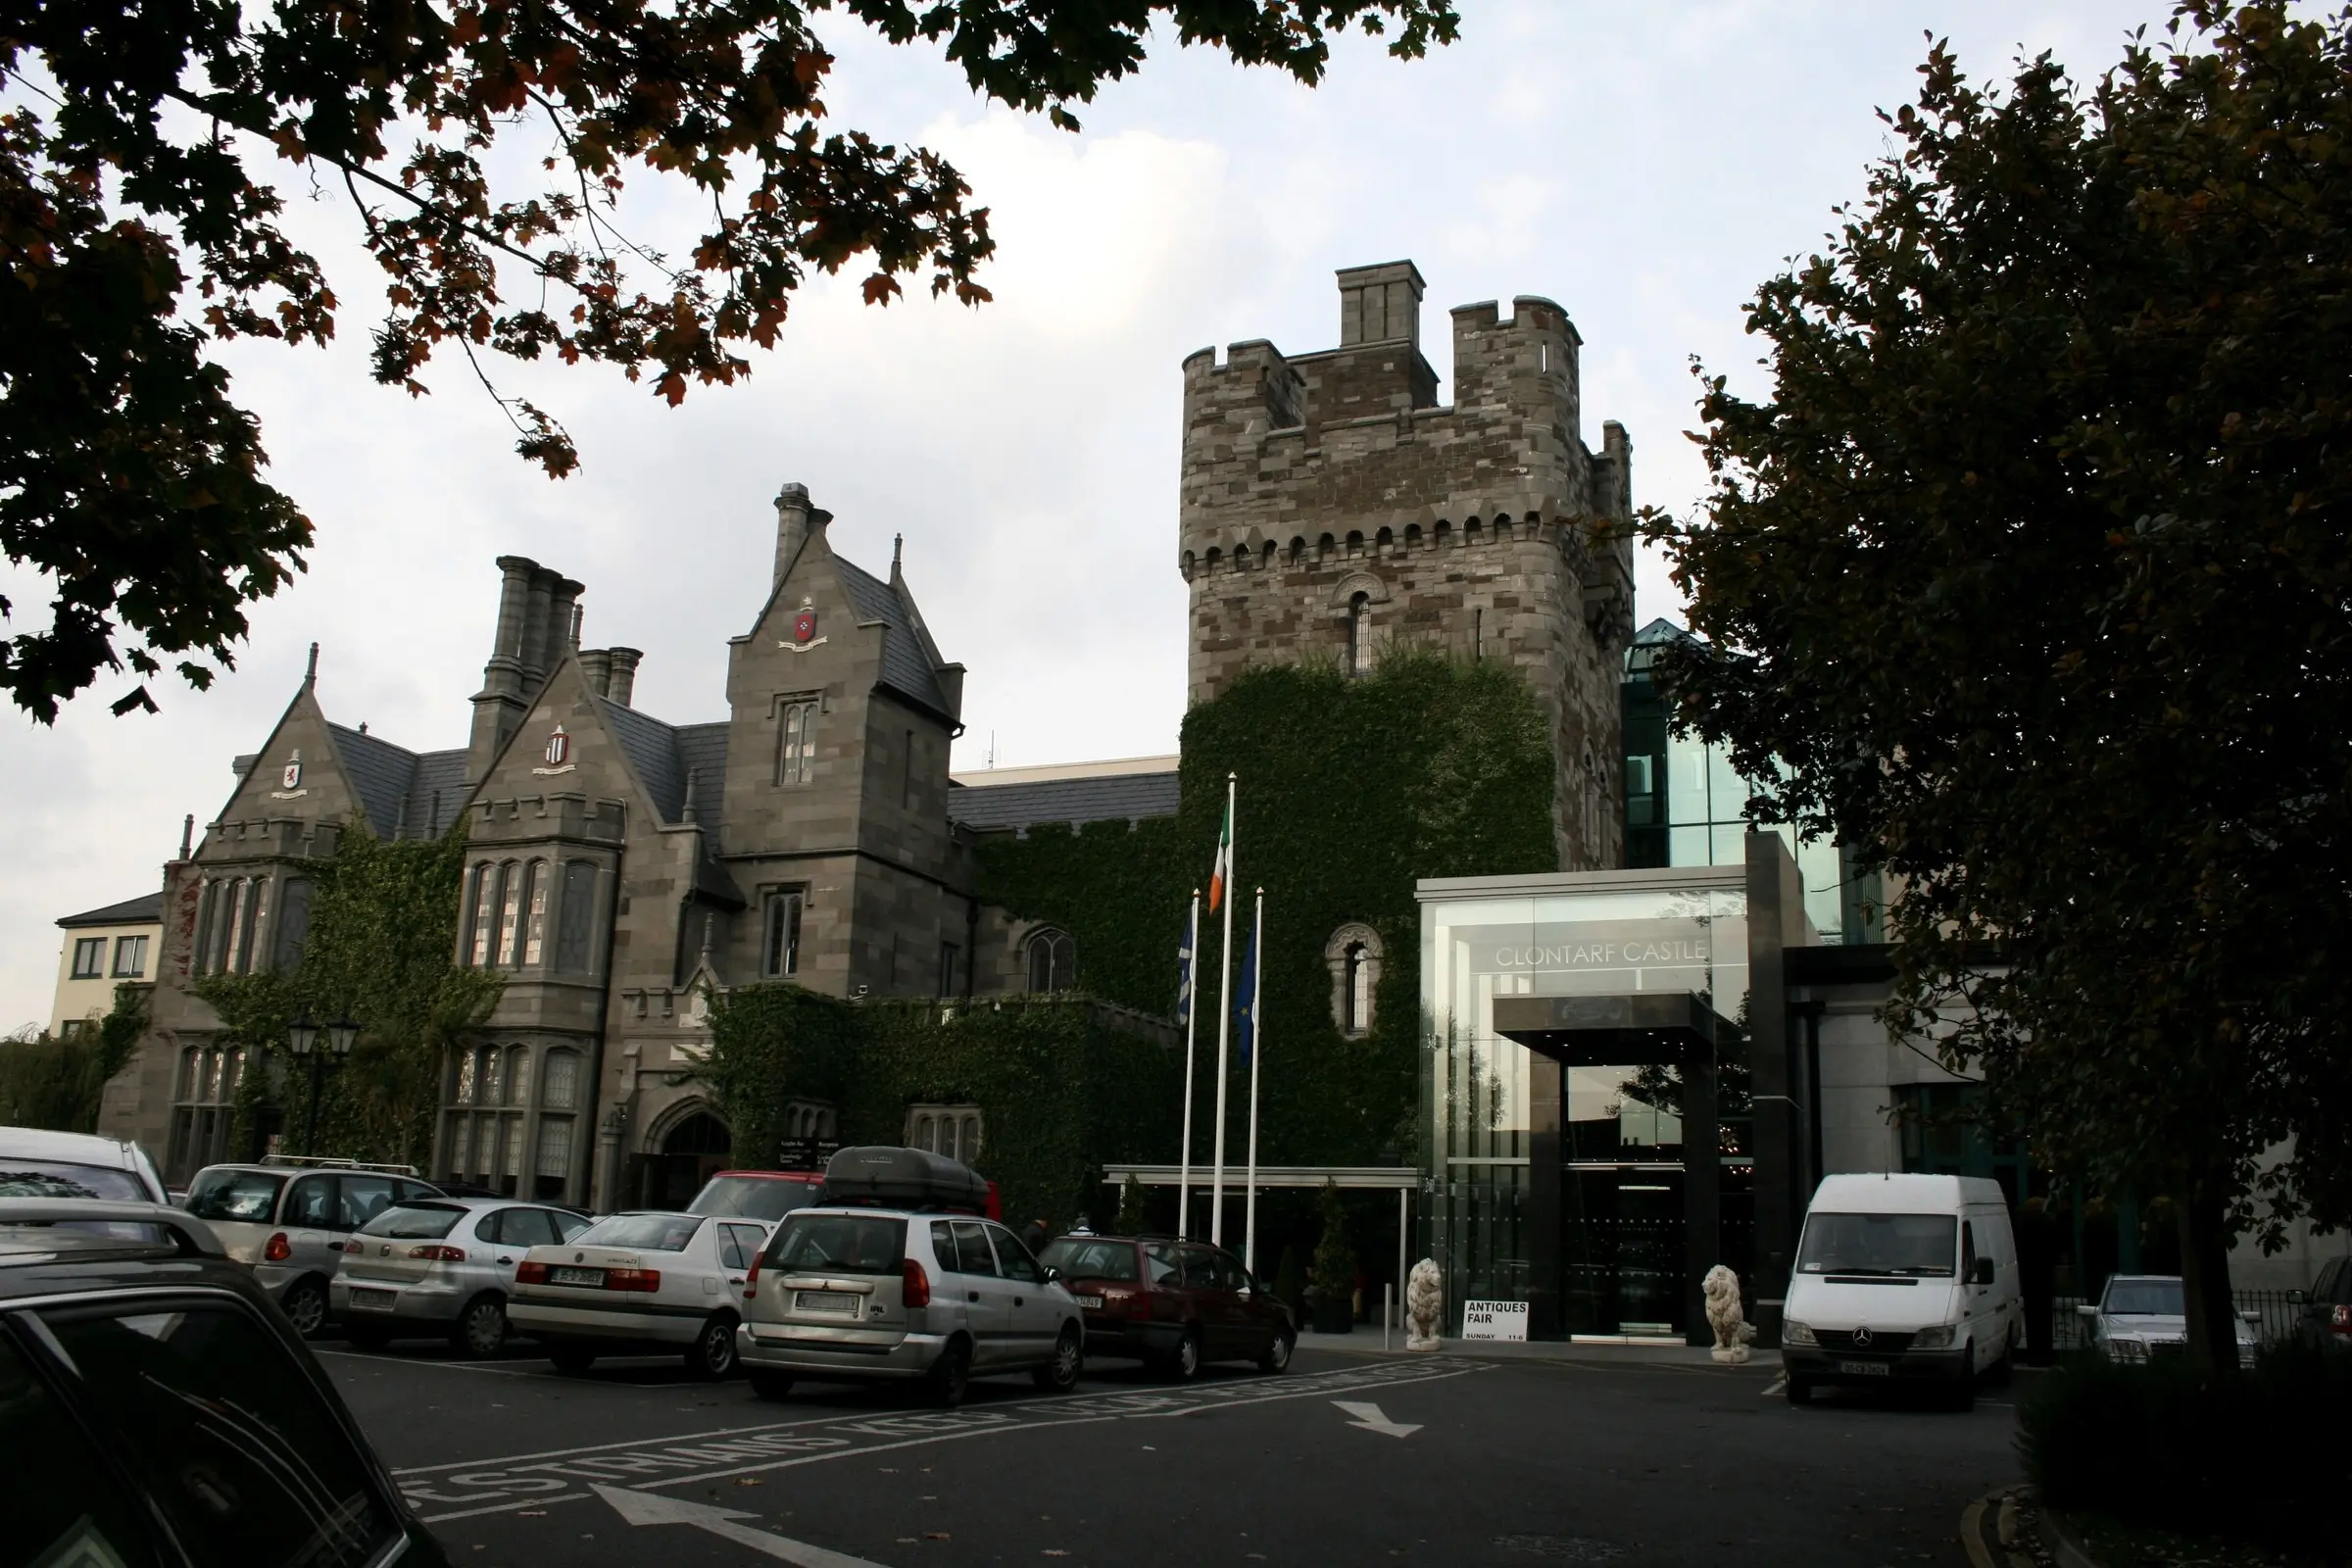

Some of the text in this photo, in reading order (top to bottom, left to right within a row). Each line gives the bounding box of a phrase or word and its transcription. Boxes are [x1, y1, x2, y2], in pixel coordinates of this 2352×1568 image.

[1495, 940, 1707, 966] CLONTARF CASTLE
[1468, 1301, 1526, 1312] ANTIQUES
[1467, 1313, 1493, 1323] FAIR
